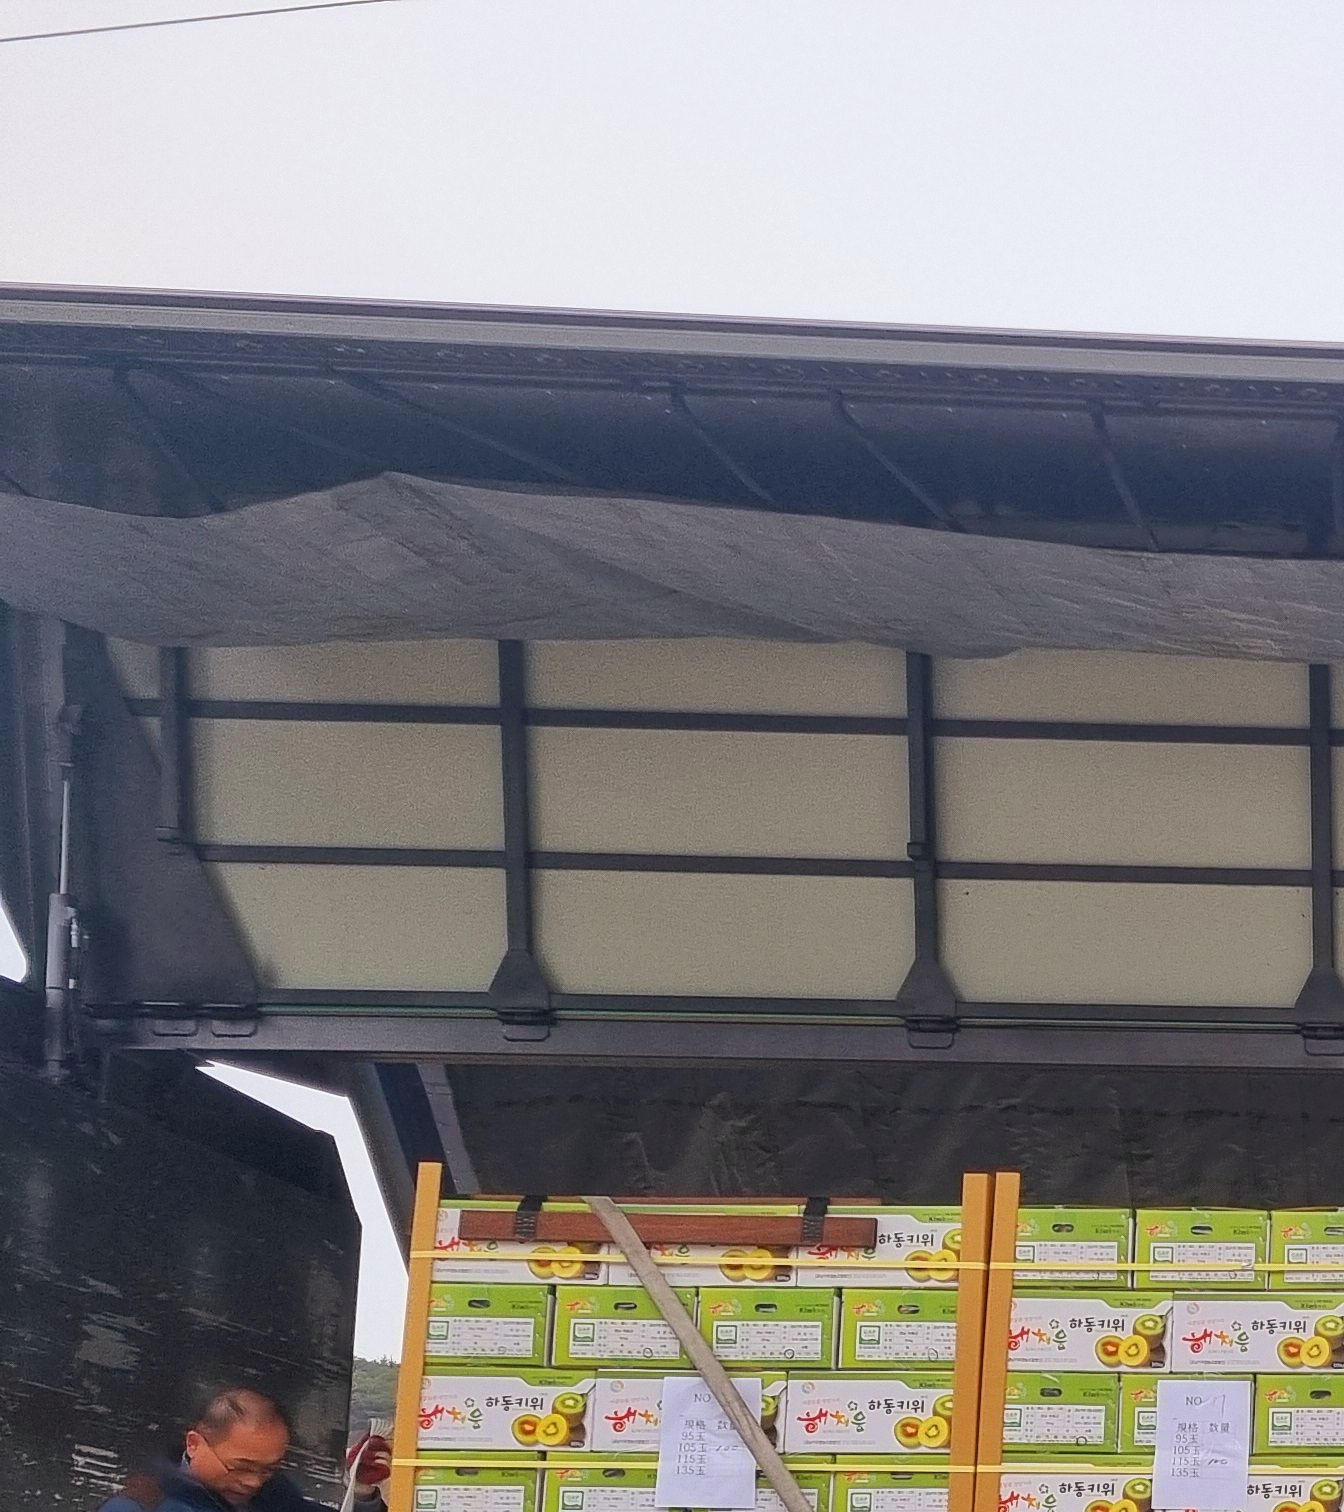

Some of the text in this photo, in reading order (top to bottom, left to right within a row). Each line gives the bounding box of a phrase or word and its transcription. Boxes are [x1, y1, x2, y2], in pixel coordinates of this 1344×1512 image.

[878, 1232, 934, 1248] 하동키위
[1069, 1317, 1125, 1333] 하동키위
[1251, 1319, 1307, 1335] 하동키위
[485, 1395, 544, 1412] 하동키위
[693, 1393, 712, 1403] NO
[1185, 1396, 1203, 1406] NO
[868, 1398, 925, 1415] 하동키위
[1059, 1481, 1115, 1498] 하동키위
[1246, 1483, 1302, 1499] 하동키위
